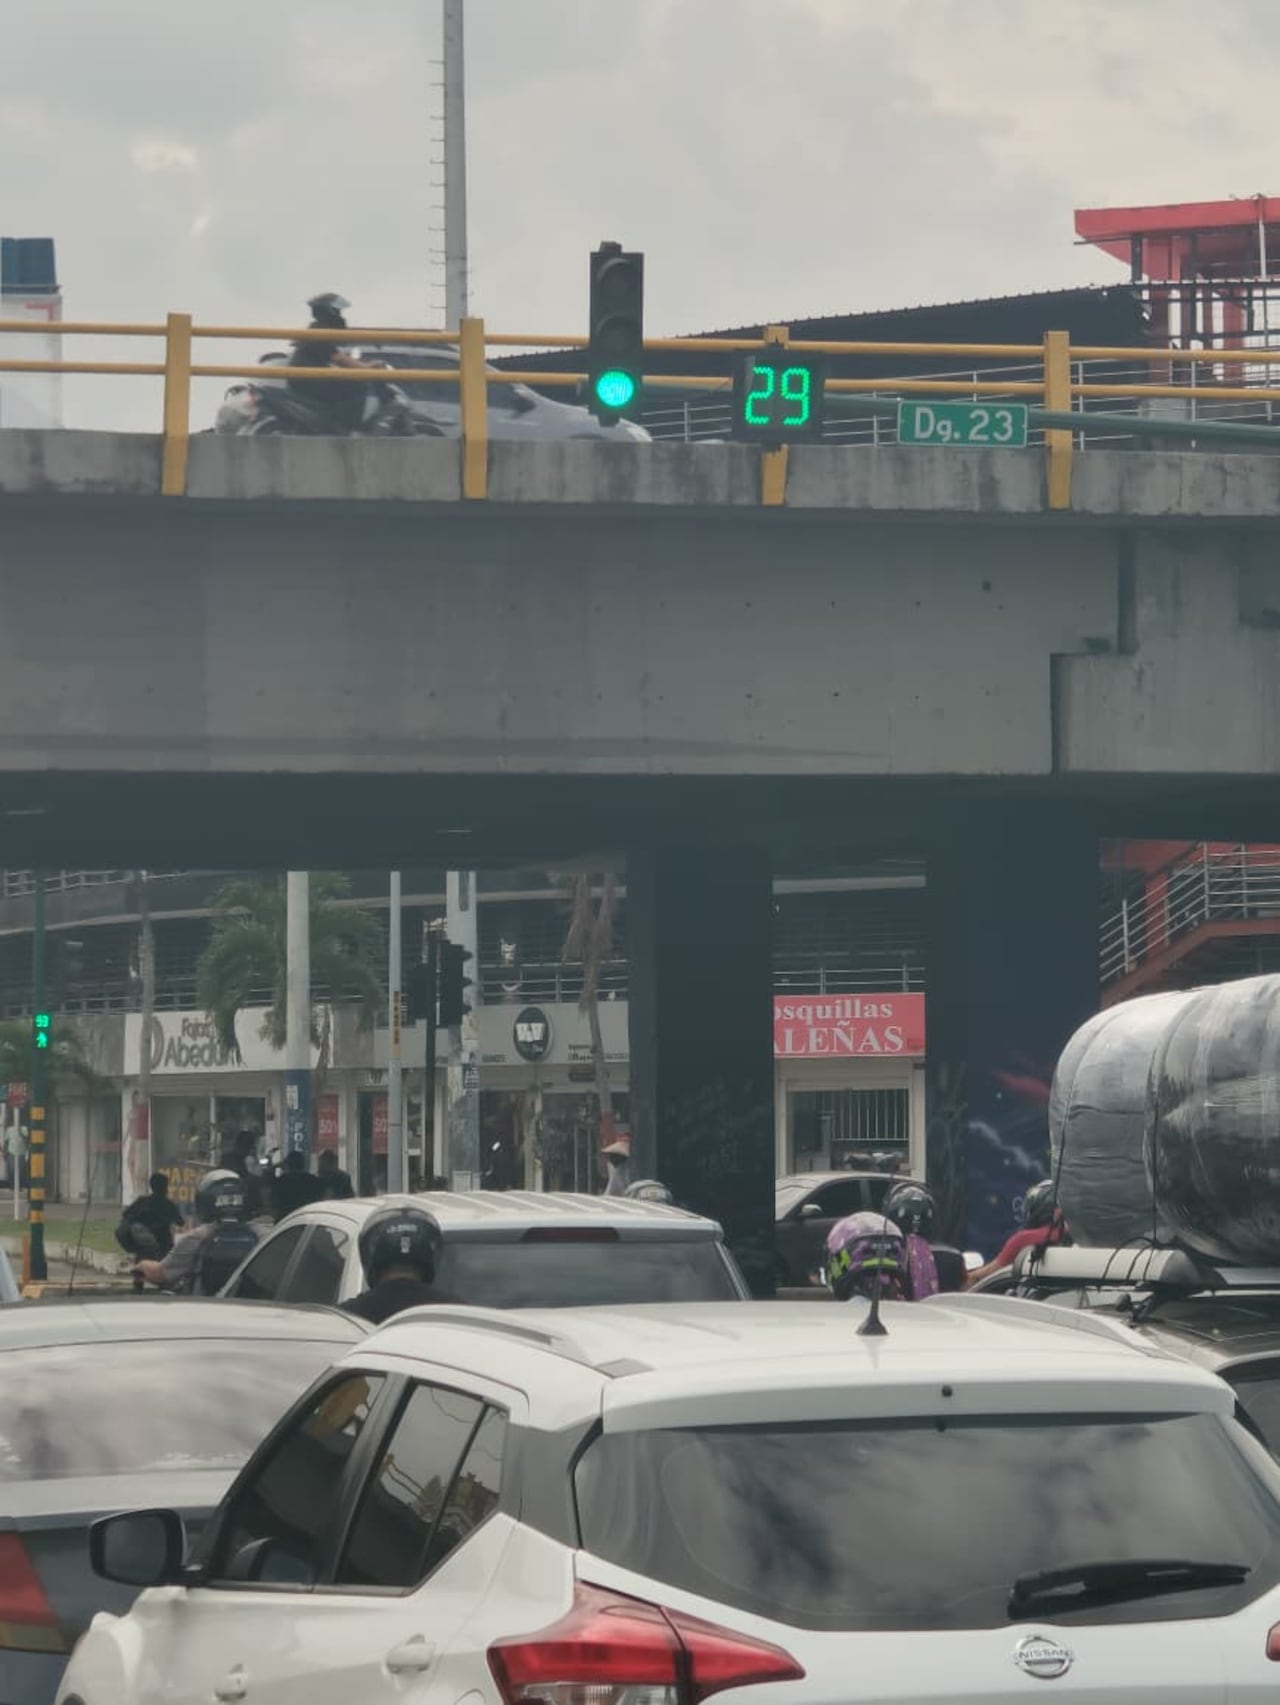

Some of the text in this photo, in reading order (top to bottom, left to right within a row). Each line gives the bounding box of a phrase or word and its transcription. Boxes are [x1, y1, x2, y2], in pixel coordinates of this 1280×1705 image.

[745, 366, 810, 426] 29
[914, 406, 1013, 442] Dg. 23
[1018, 1649, 1069, 1660] NISSAN
